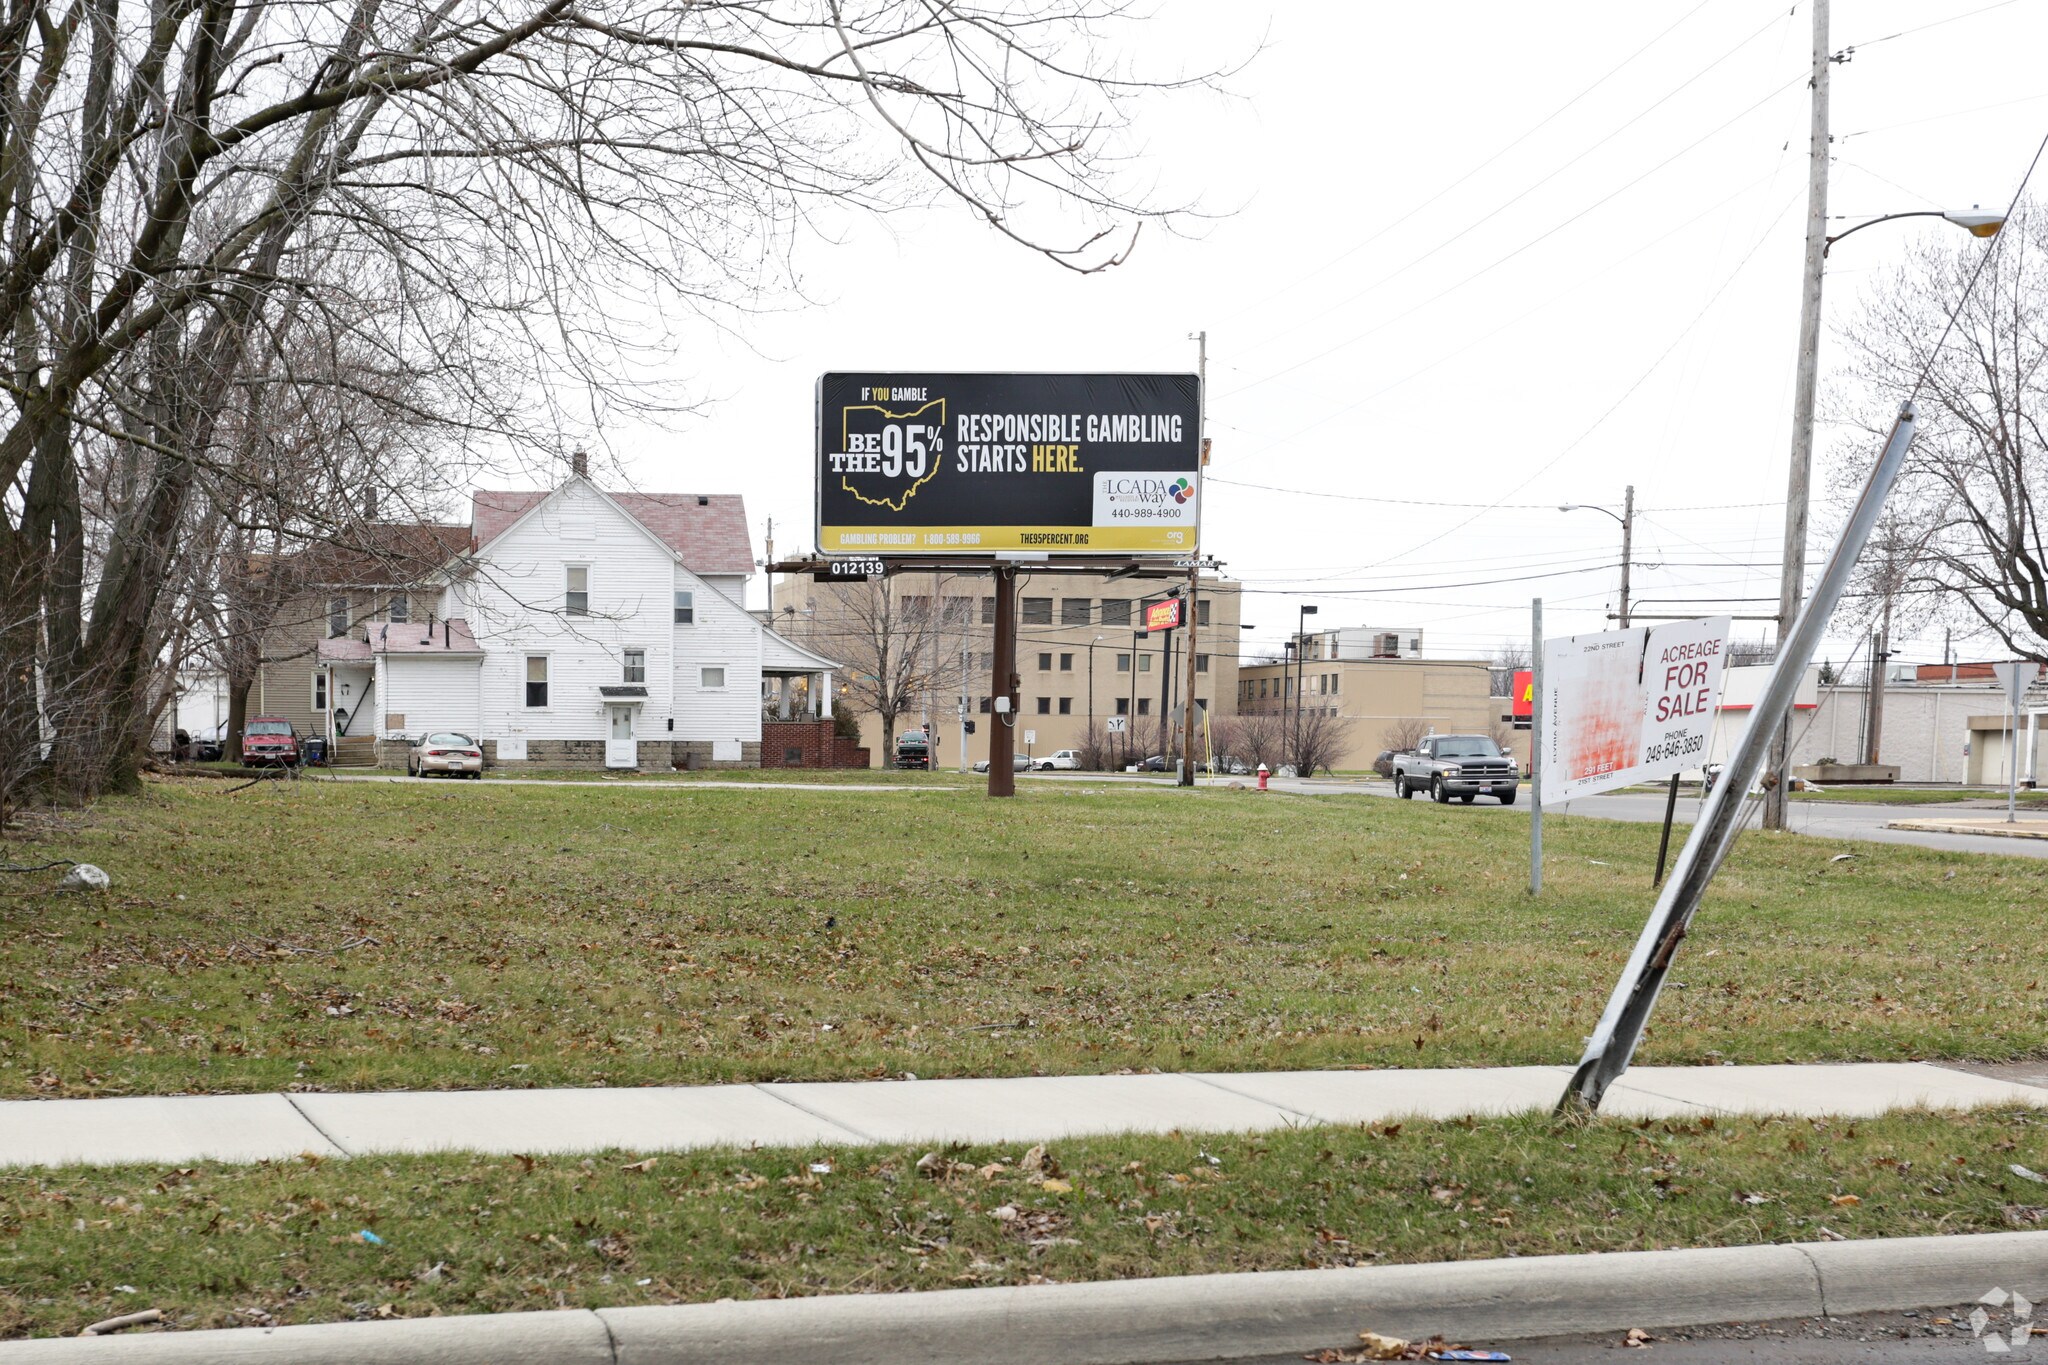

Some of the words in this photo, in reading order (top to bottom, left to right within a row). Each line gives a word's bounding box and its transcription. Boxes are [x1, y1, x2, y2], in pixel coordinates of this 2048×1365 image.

[861, 387, 870, 401] IF
[872, 387, 890, 401] YOU
[891, 387, 928, 401] GAMBLE
[957, 414, 1081, 442] RESPONSIBLE
[1086, 414, 1182, 443] GAMBLING
[848, 433, 881, 453] BE
[882, 424, 944, 478] 95%
[956, 444, 1027, 473] STARTS
[1032, 444, 1084, 473] HERE.
[829, 453, 881, 473] THE
[1107, 479, 1166, 494] LCADA
[1139, 492, 1167, 508] way
[1111, 508, 1181, 518] 440-989-4900
[840, 533, 878, 545] GAMBLING
[878, 533, 916, 545] PROBLEM?
[923, 533, 981, 545] 1-800-589-9966
[1020, 533, 1089, 545] THE95PERCENT.ORG
[1167, 531, 1184, 544] org
[832, 562, 884, 574] 012139
[1583, 644, 1600, 653] 22ND
[1601, 641, 1625, 650] STREET
[1660, 638, 1721, 664] ACREAGE
[1665, 661, 1709, 692] FOR
[1656, 688, 1710, 723] SALE
[1664, 728, 1688, 741] PHONE
[1645, 734, 1704, 764] 248-646-3850
[1597, 761, 1614, 773] FEET
[1578, 776, 1591, 786] 21ST
[1592, 773, 1614, 783] STREET
